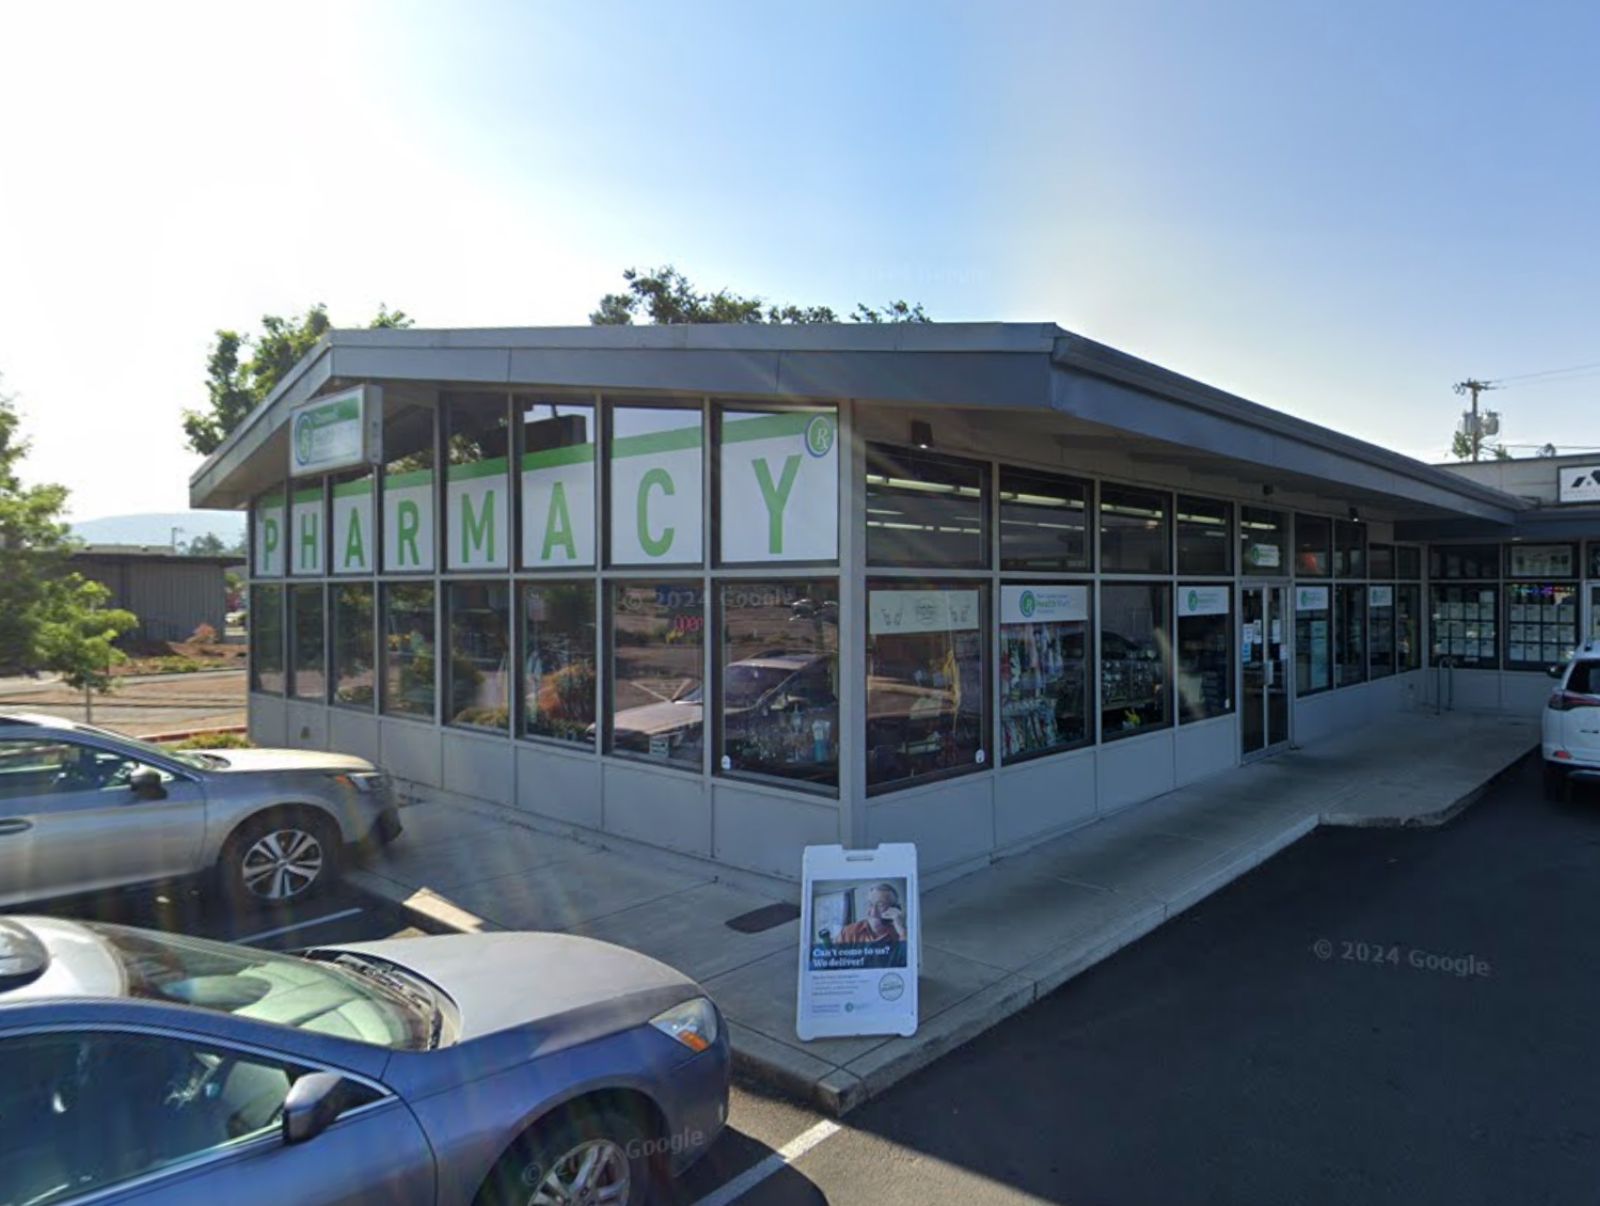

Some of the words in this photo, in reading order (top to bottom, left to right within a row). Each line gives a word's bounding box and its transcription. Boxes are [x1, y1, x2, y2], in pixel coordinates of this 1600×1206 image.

[264, 455, 802, 571] PHARMACY
[812, 948, 837, 957] Can't
[838, 949, 863, 957] come
[864, 947, 874, 955] to
[875, 945, 890, 955] us?
[813, 959, 828, 968] We
[828, 957, 864, 968] deliver!
